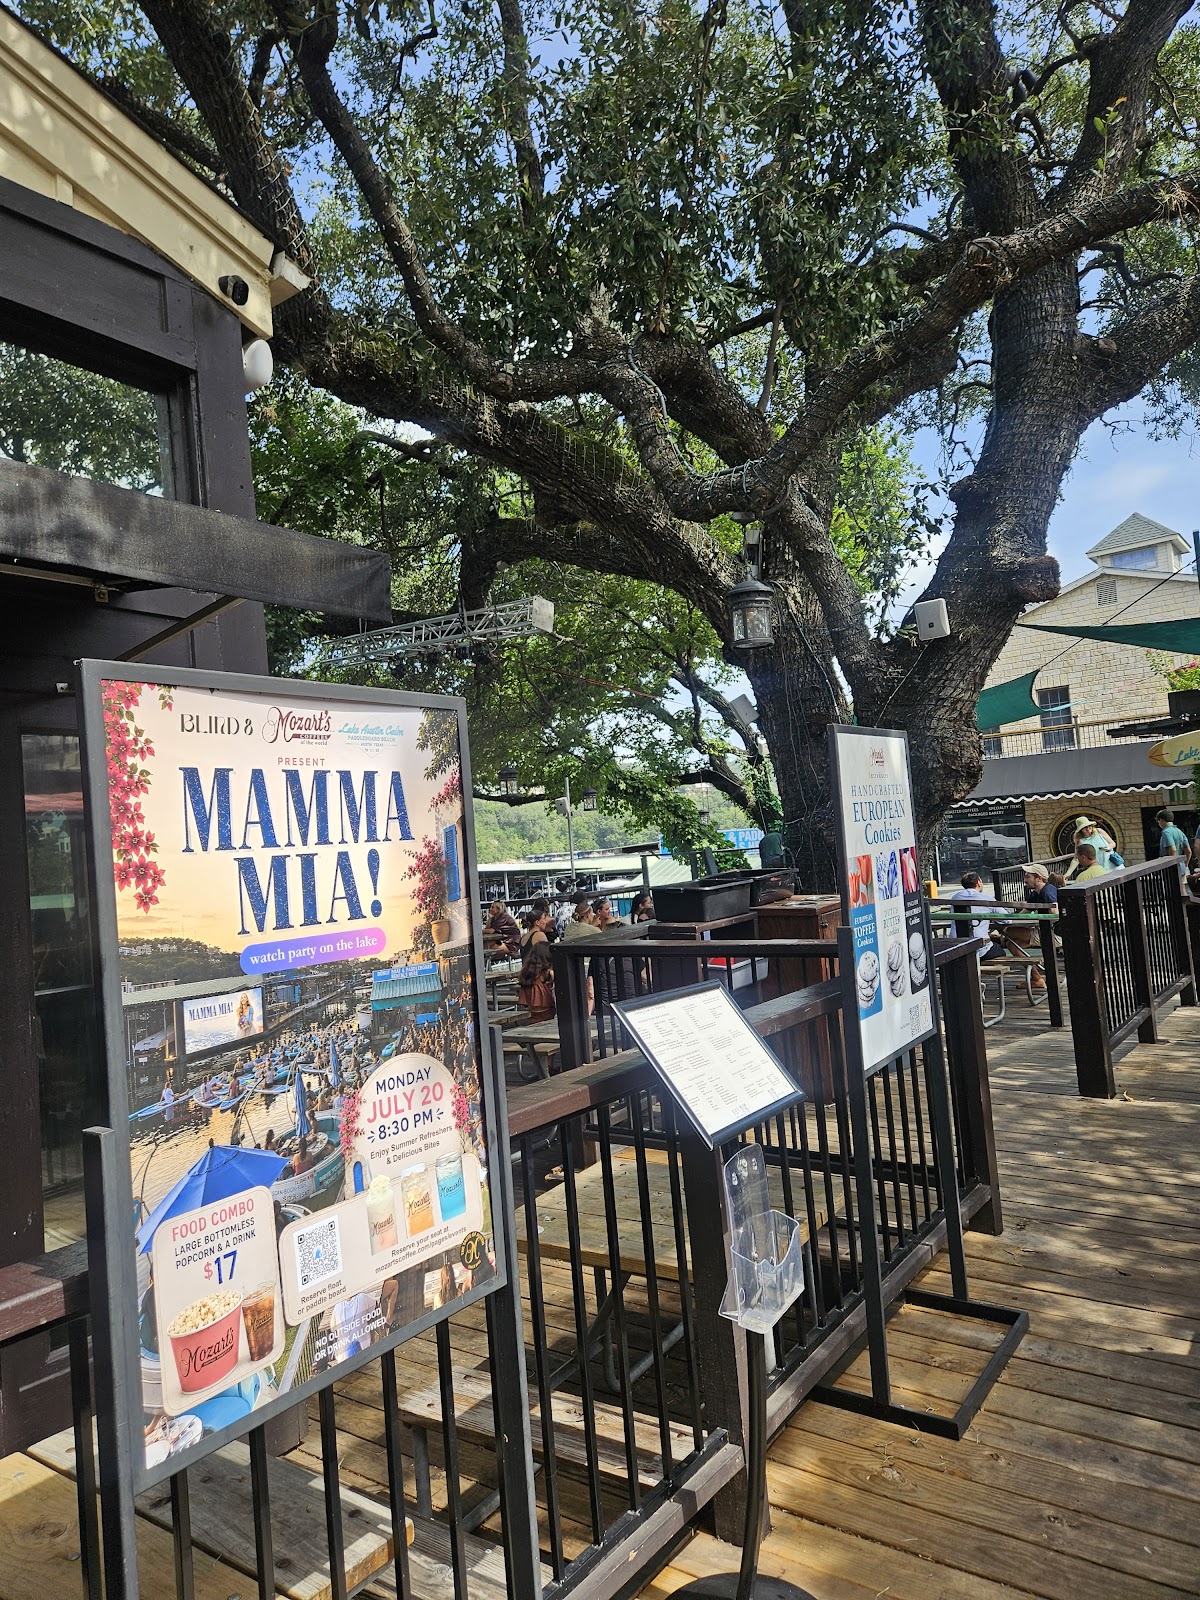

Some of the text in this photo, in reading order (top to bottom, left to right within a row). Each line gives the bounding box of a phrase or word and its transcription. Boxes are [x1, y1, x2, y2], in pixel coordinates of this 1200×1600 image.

[181, 713, 240, 735] BLIND
[262, 706, 331, 743] Mozart's
[338, 722, 359, 734] Lake
[360, 723, 384, 736] Austin
[277, 756, 326, 767] PRESENT
[1173, 745, 1200, 765] Lake
[851, 783, 904, 797] HANDCRAFTED
[178, 766, 416, 854] MAMMA
[852, 799, 906, 822] EUROPEAN
[728, 831, 737, 842] &
[864, 820, 902, 845] Cookies
[233, 848, 383, 936] MIA!
[854, 922, 876, 939] TOFFEE
[857, 936, 874, 948] Cookies
[249, 935, 378, 965] watch party on the lake
[188, 1001, 234, 1021] MAMMA MIA!
[375, 1066, 432, 1095] MONDAY
[366, 1081, 444, 1123] JULY 20
[378, 1108, 433, 1140] 8:30 PM
[370, 1124, 453, 1160] Enjoy Summer Refreshers
[386, 1140, 440, 1165] & Delicious Bites
[172, 1198, 254, 1242] FOOD COMBO
[174, 1216, 255, 1257] LARGE BOTTOMLESS
[175, 1228, 256, 1270] POPCORN & A DRINK
[391, 1241, 415, 1258] Reserve
[416, 1235, 430, 1249] your
[430, 1229, 443, 1239] seat
[203, 1249, 238, 1285] $17
[297, 1286, 347, 1316] or paddle board
[300, 1279, 342, 1304] Reserve float
[315, 1316, 387, 1362] OR DRINK ALLOWED
[316, 1307, 382, 1349] NO OUTSIDE FOOD
[181, 1327, 234, 1378] Mozart's
